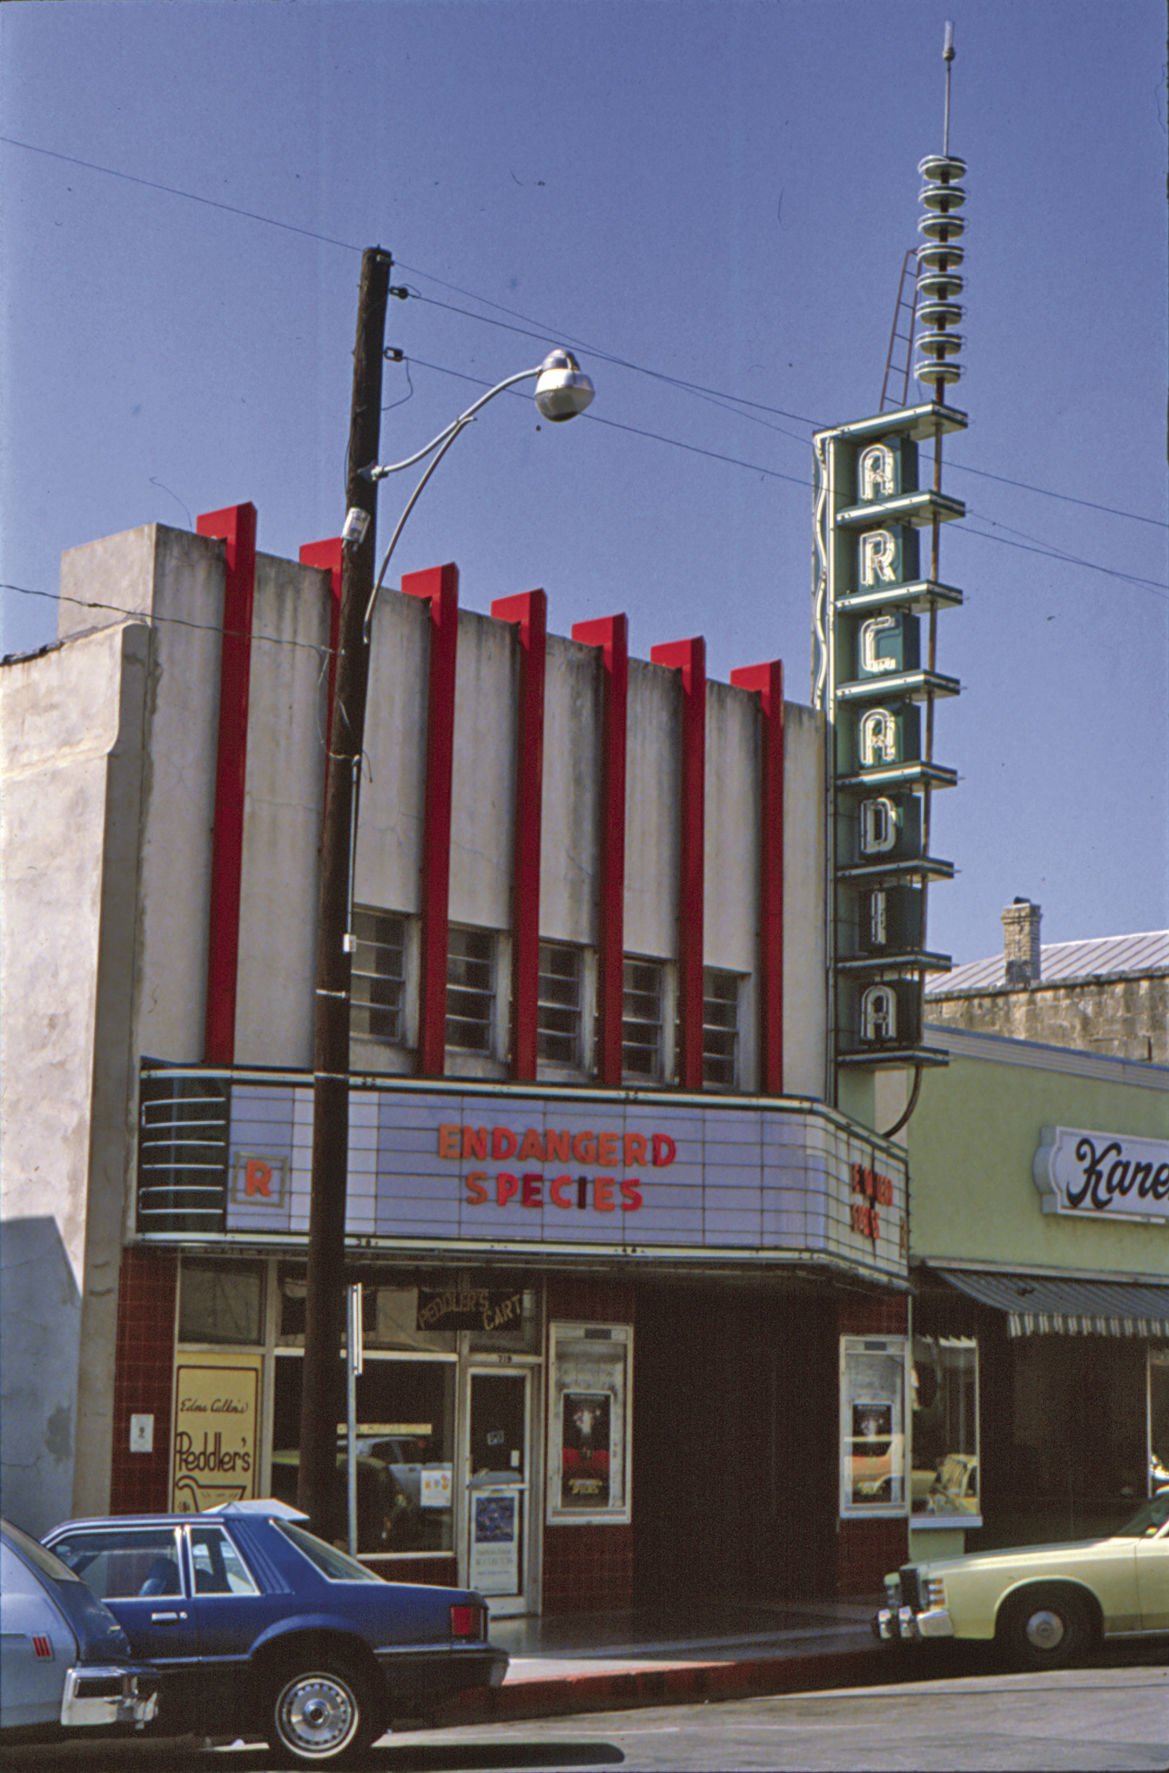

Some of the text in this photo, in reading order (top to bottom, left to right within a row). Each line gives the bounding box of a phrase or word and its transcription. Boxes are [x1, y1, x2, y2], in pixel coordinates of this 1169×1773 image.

[858, 443, 897, 1041] ARCADIA
[437, 1123, 677, 1168] ENDANGERD
[245, 1159, 272, 1197] R
[465, 1171, 643, 1211] SPECIES
[483, 1294, 520, 1330] CART
[176, 1431, 251, 1473] Peddler's
